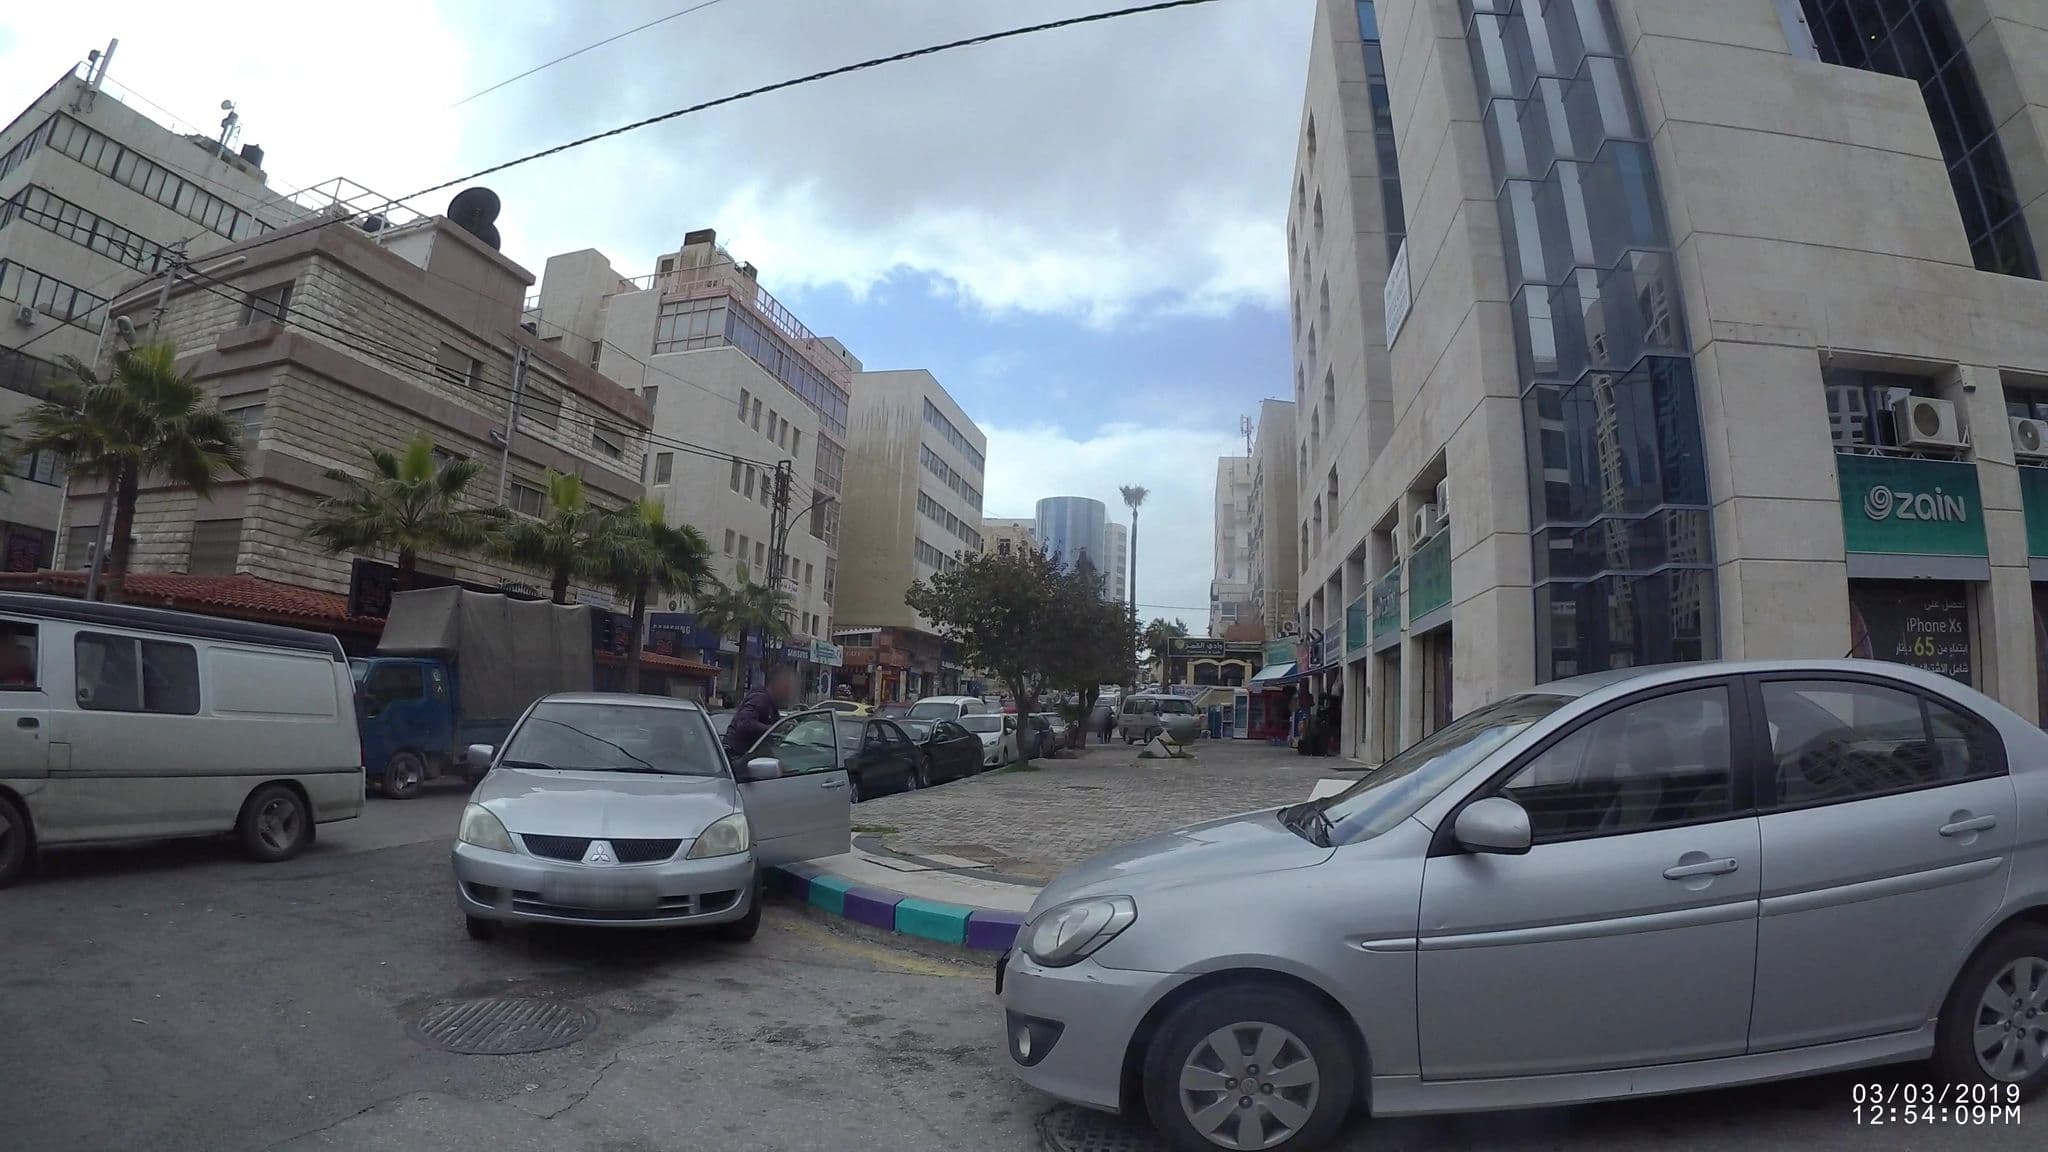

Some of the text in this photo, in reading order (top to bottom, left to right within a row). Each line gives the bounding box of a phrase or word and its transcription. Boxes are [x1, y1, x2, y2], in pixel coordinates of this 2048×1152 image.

[1893, 487, 1966, 523] zain
[1906, 617, 1962, 633] iPhone Xs
[1914, 636, 1935, 657] 65
